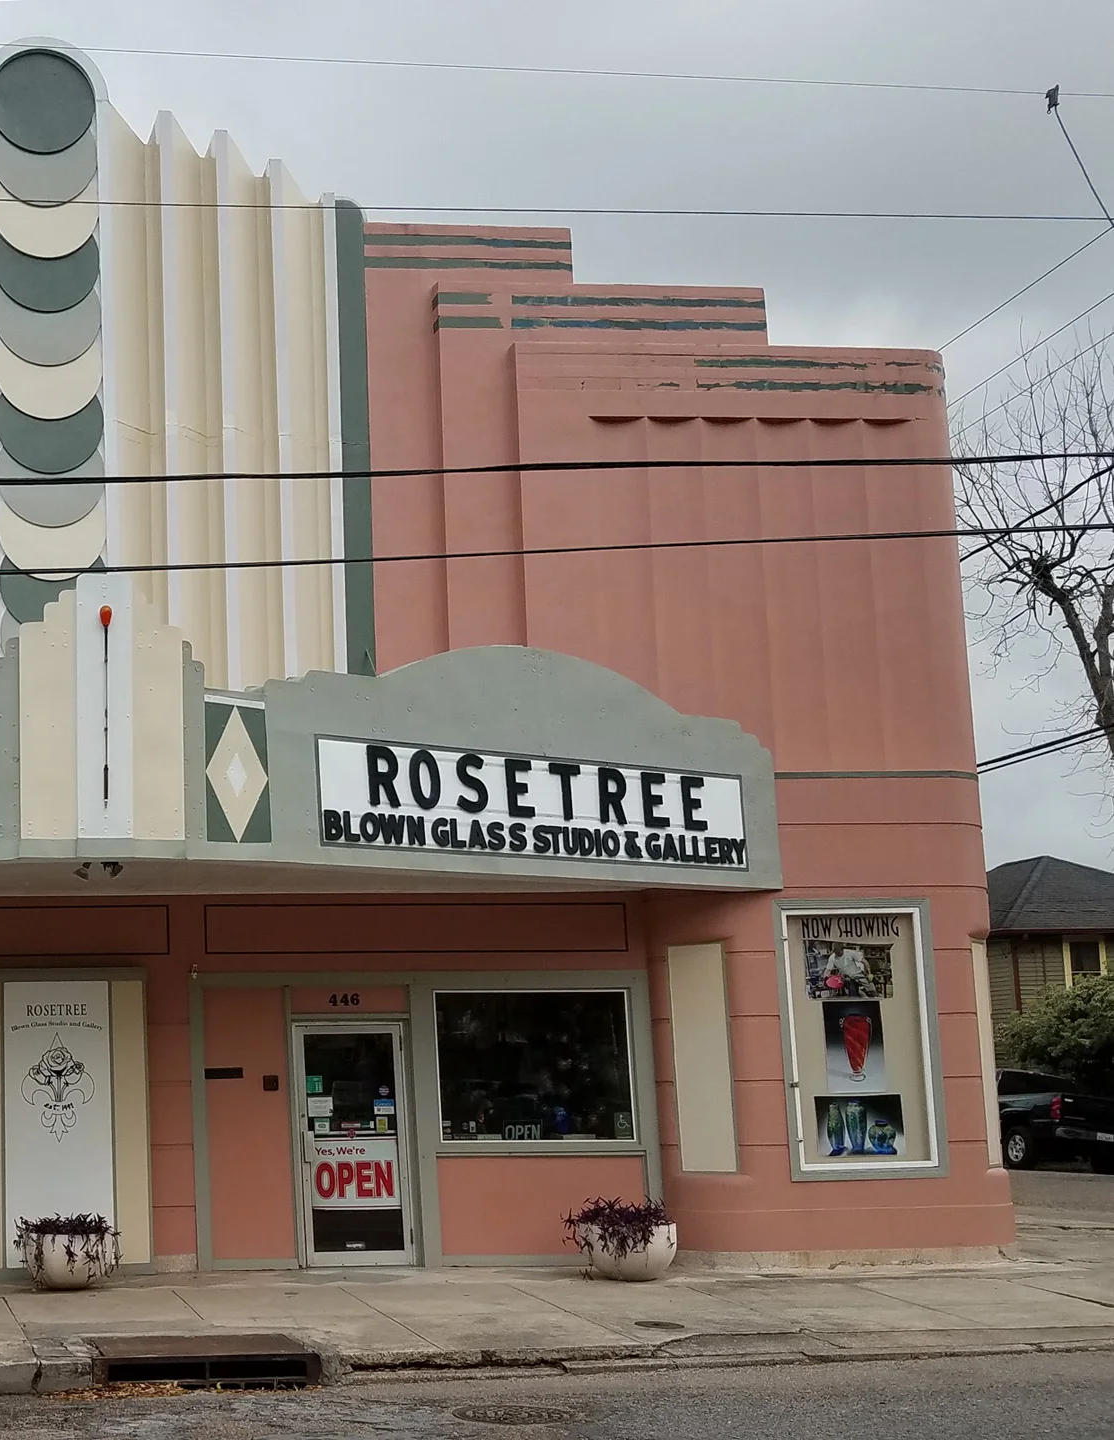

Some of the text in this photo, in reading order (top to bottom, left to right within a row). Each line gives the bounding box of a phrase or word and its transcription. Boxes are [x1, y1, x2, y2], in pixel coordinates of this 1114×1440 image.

[366, 744, 709, 832] ROSETREE
[323, 809, 746, 865] BLOWN GLASS STUDIO & GALLERY
[800, 915, 900, 939] NOW SHOWING
[328, 993, 361, 1007] 446
[26, 1003, 88, 1017] ROSETREE
[81, 1021, 104, 1032] Gallery
[315, 1146, 366, 1156] Yes, We're
[314, 1160, 395, 1199] OPEN
